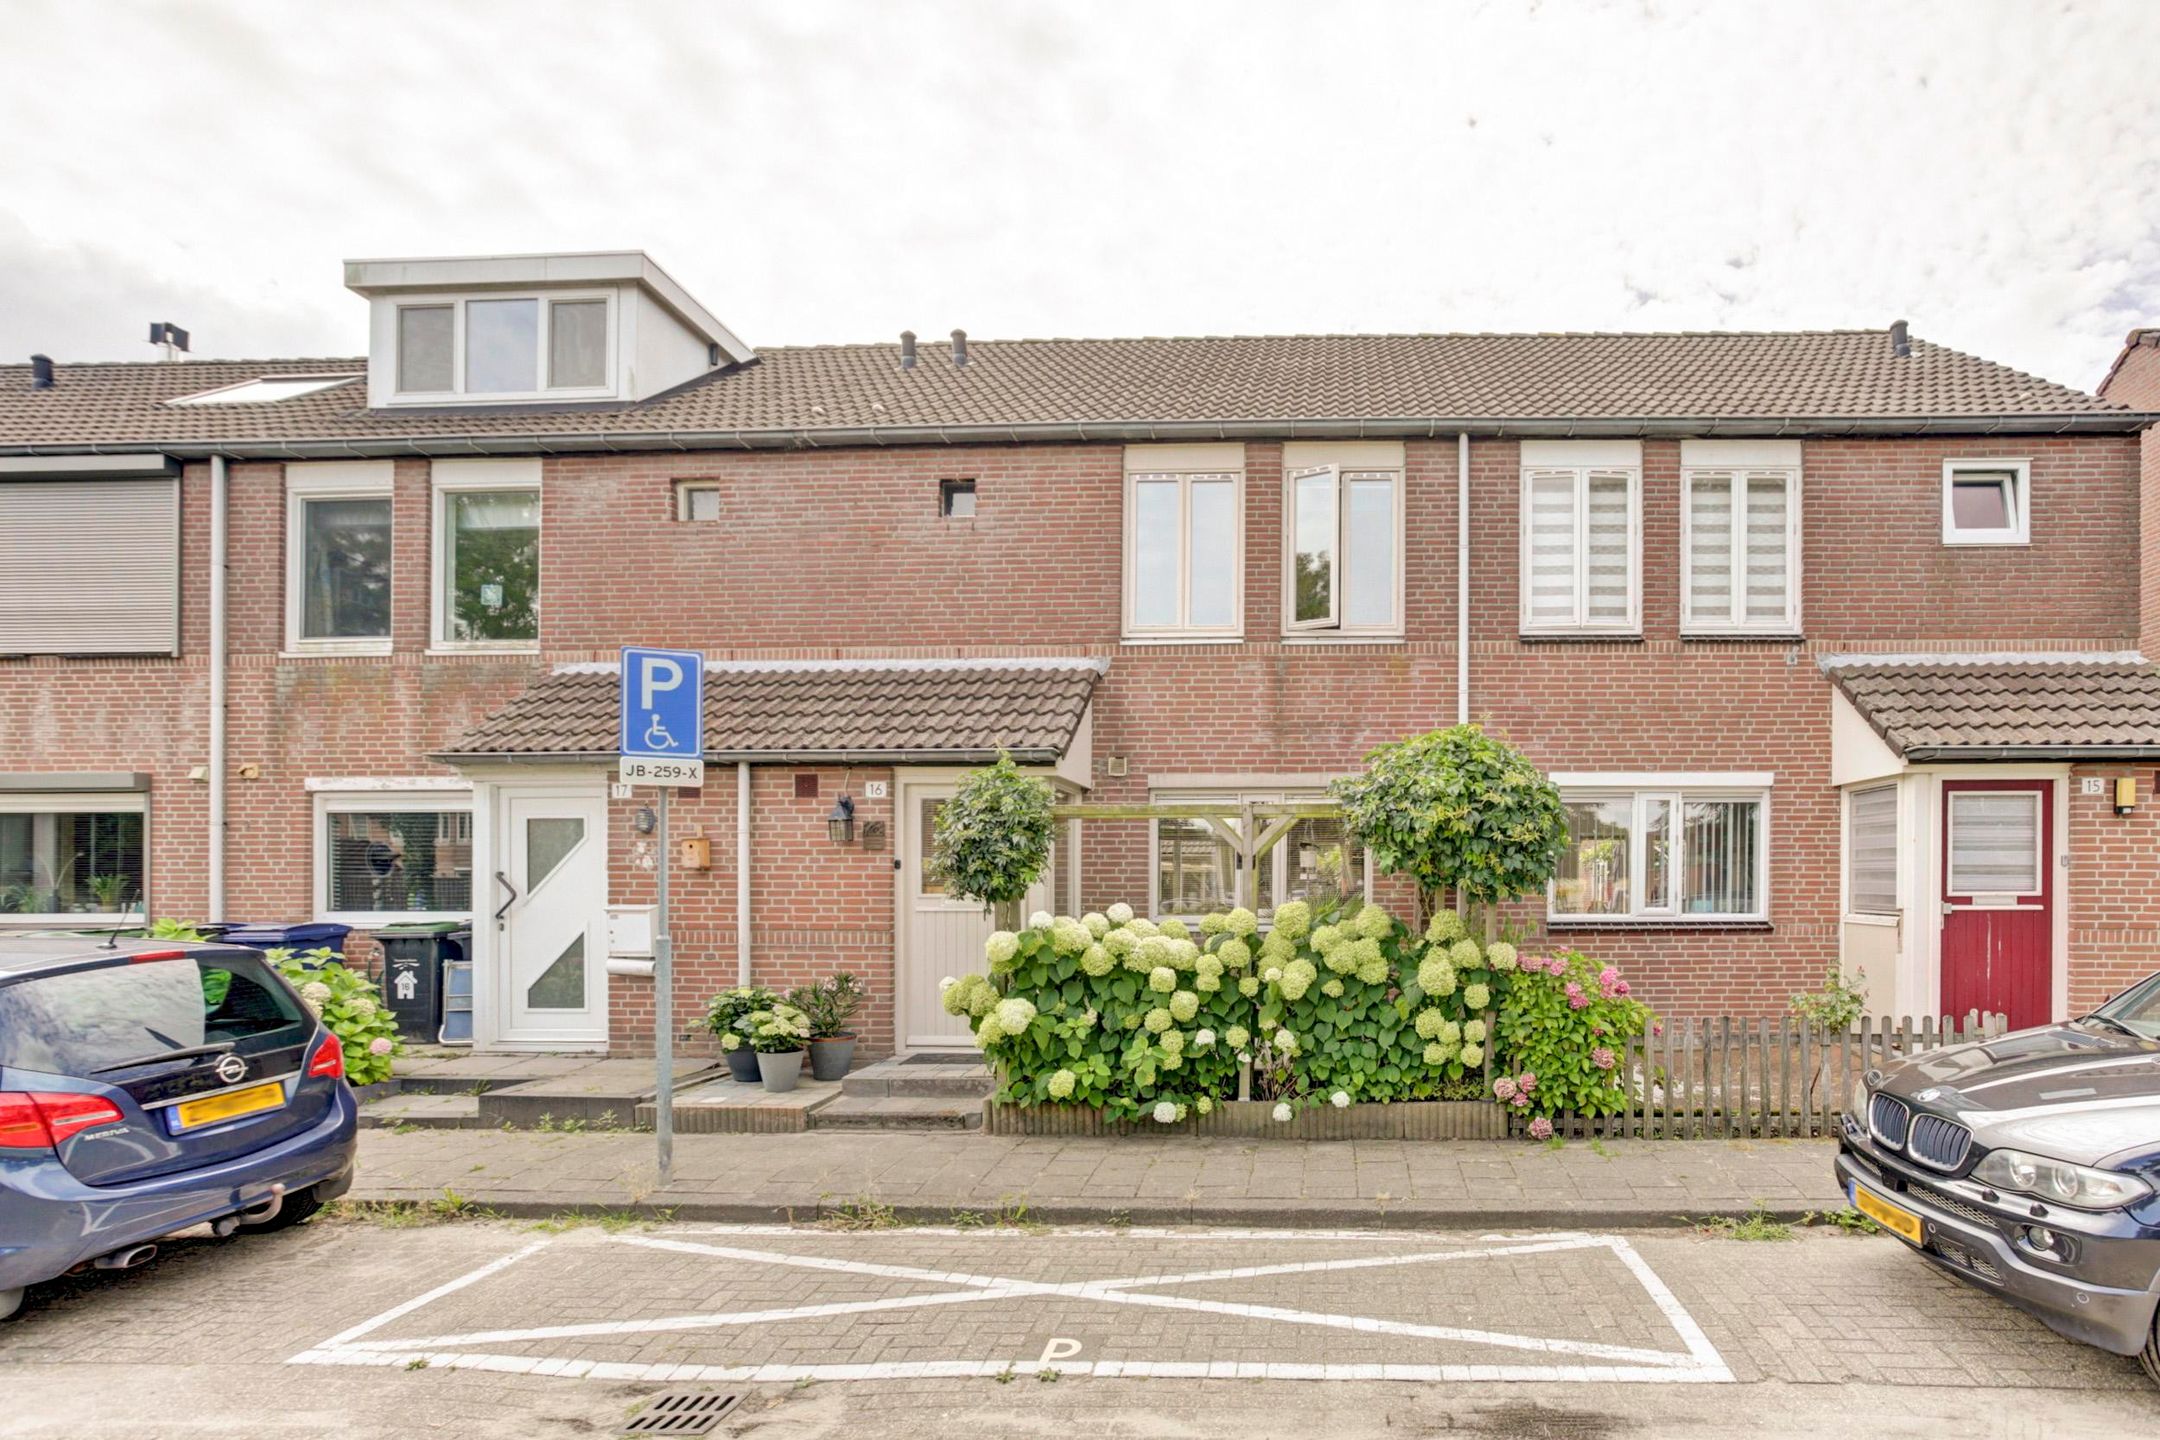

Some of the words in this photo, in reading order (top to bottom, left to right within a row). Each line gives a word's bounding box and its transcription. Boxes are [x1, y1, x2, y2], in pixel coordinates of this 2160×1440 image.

[641, 657, 684, 710] P
[625, 764, 699, 779] JB-259-X
[615, 785, 628, 797] 17
[870, 783, 884, 796] 16
[2087, 779, 2101, 793] 15
[1039, 1338, 1083, 1366] P
